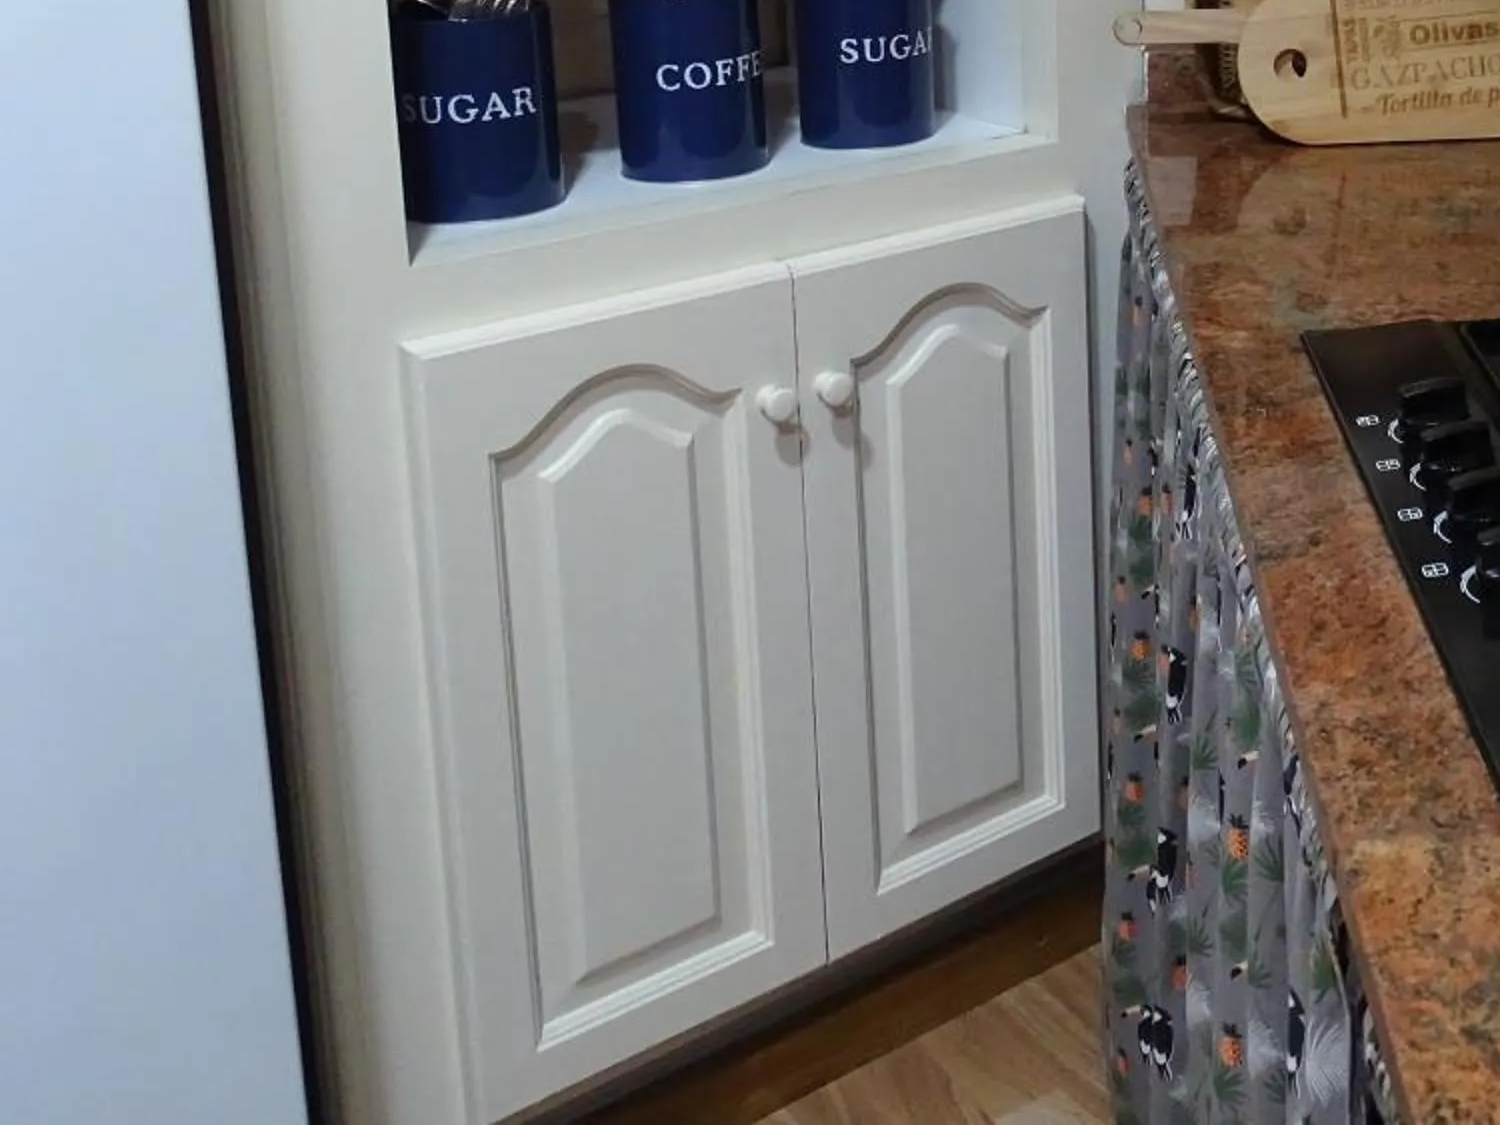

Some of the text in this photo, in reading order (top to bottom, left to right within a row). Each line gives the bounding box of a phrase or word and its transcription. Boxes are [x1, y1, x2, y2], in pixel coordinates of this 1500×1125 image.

[1409, 21, 1500, 45] Olivas
[402, 86, 537, 124] SUGAR
[1377, 91, 1453, 115] Tortilla
[1459, 86, 1482, 106] de
